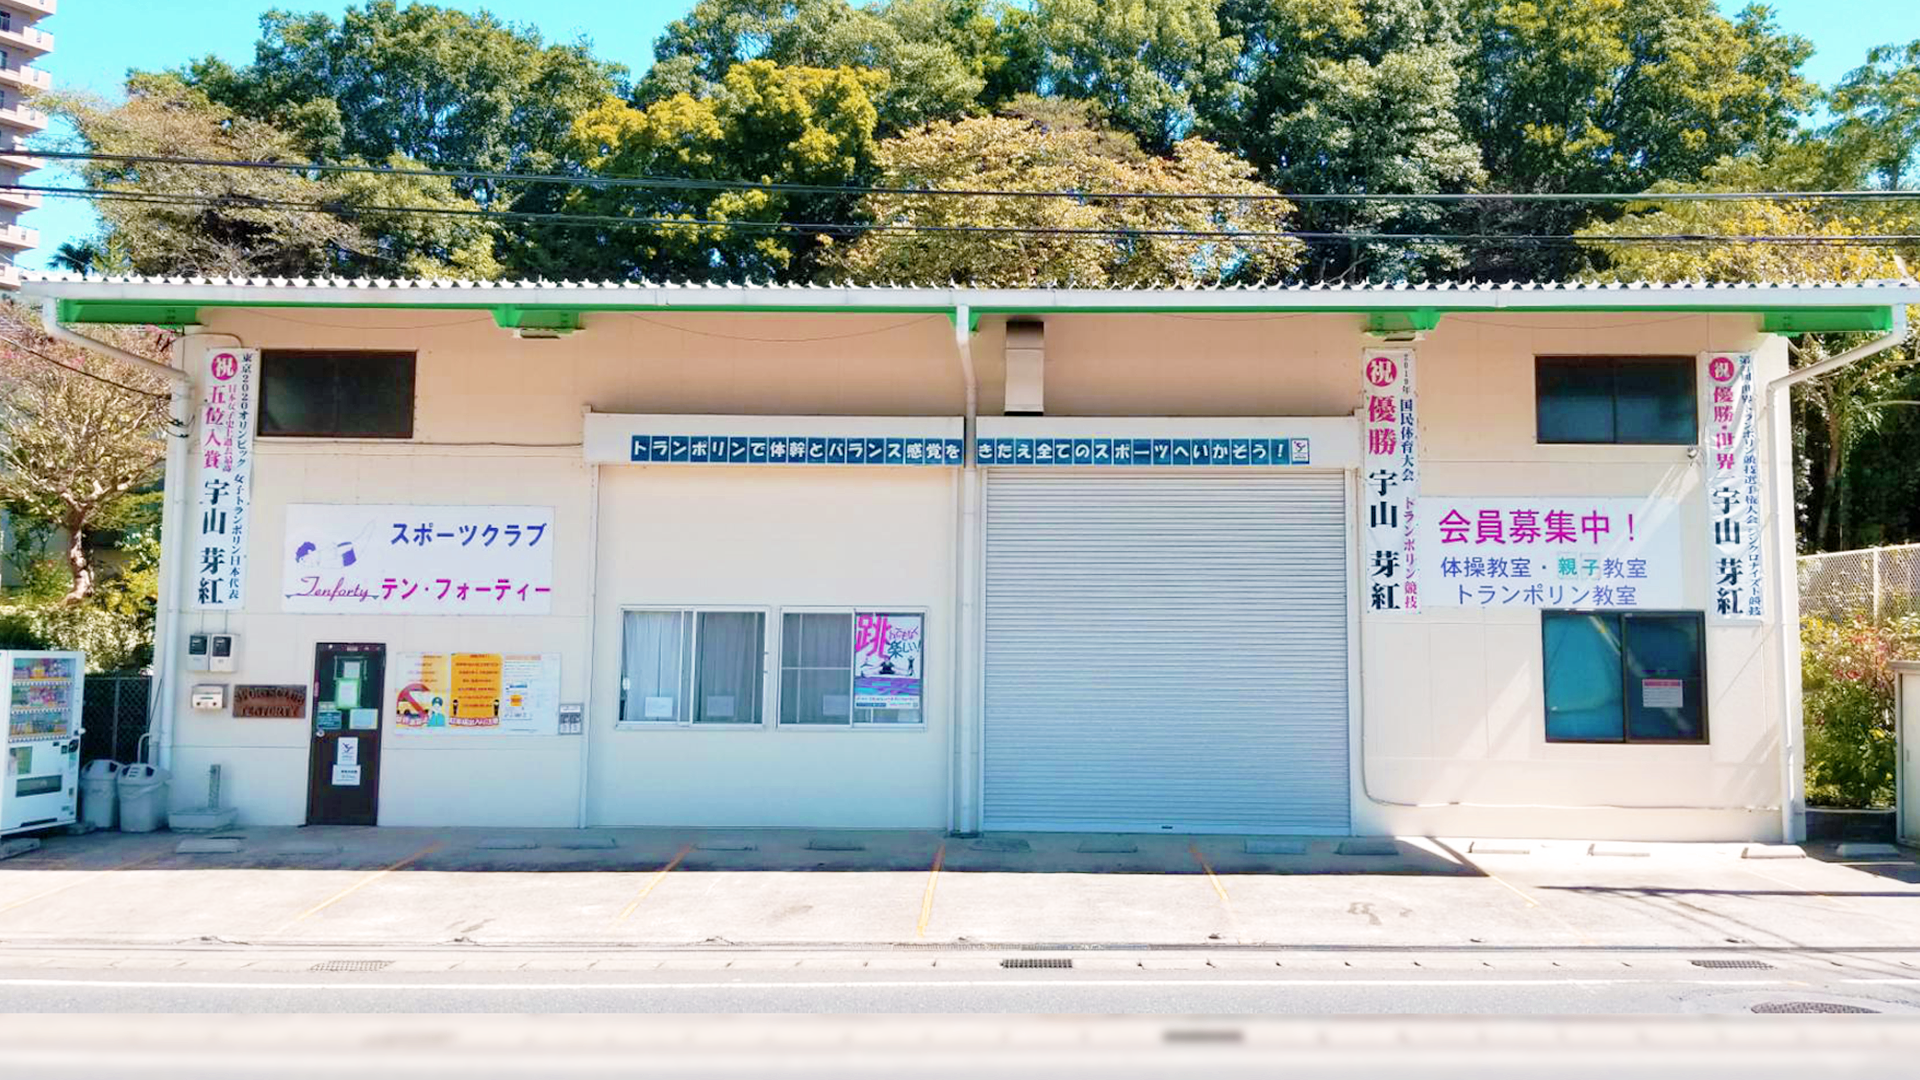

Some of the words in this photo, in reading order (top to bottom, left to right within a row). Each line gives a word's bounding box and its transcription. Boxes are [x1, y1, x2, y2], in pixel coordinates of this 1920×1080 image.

[213, 355, 236, 379] 祝
[1367, 358, 1396, 386] 祝
[1711, 359, 1733, 380] 祝
[203, 386, 226, 469] 五位入賞
[236, 352, 253, 468] 東京2020オリンピック
[1368, 395, 1397, 455] 優勝
[633, 439, 960, 460] トランポリンで体幹とバランス感覚を
[977, 440, 1284, 460] きたえ全てのスポーツへいかそう！
[1400, 398, 1414, 482] 国民体育大会
[203, 479, 230, 535] 宇山
[1368, 469, 1398, 528] 宇山
[1713, 487, 1741, 545] 宇山
[391, 522, 547, 546] スポーツクラブ
[1439, 509, 1635, 545] 会員募集中！
[1404, 496, 1418, 609] トランポリン競技
[1441, 556, 1648, 579] 体操教室・親子教室
[198, 547, 226, 604] 芽紅
[300, 576, 369, 602] Tenforty
[382, 578, 551, 601] テン・フォーティー
[1369, 550, 1401, 610] 芽紅
[1459, 583, 1637, 606] トランポリン教室
[1715, 558, 1744, 615] 芽紅
[856, 615, 891, 660] 跳
